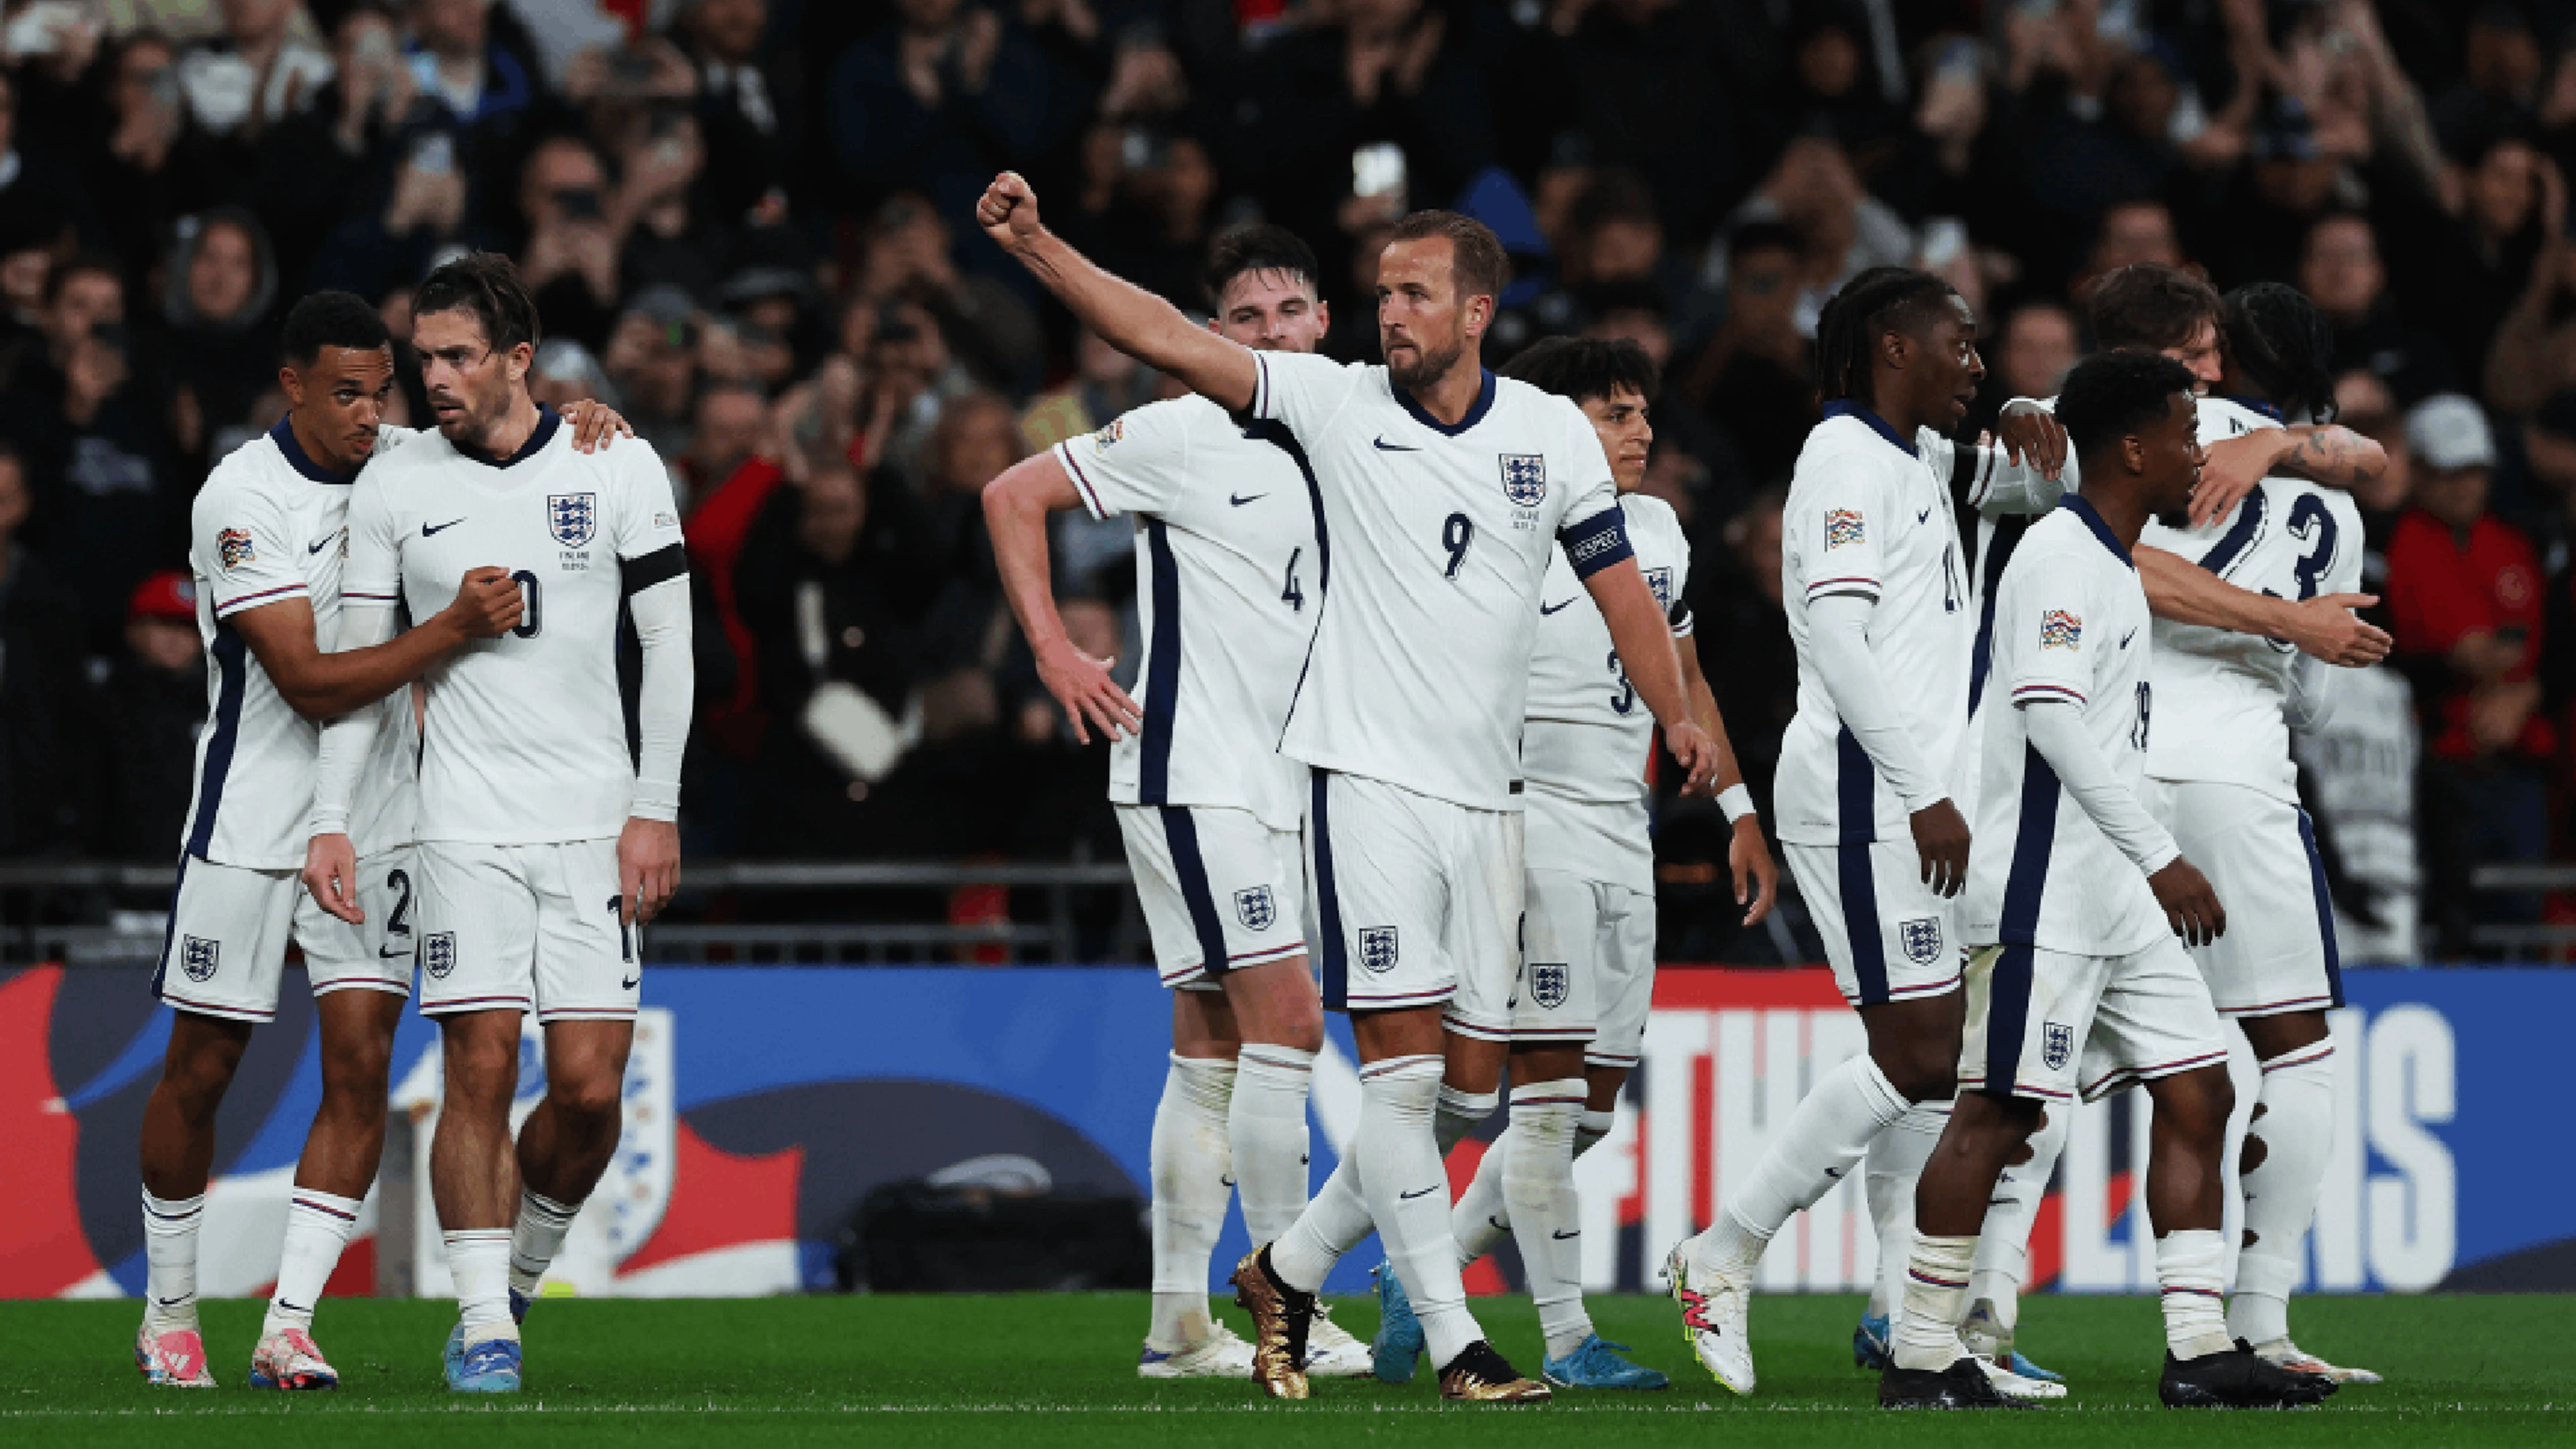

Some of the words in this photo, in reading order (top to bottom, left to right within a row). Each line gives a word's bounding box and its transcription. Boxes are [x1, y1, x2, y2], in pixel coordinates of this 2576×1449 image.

[1281, 546, 1304, 612] 4
[1442, 511, 1474, 581] 9
[512, 570, 543, 639] 0
[1607, 651, 1634, 717] 3
[387, 869, 413, 939] 2
[606, 895, 642, 963] 1
